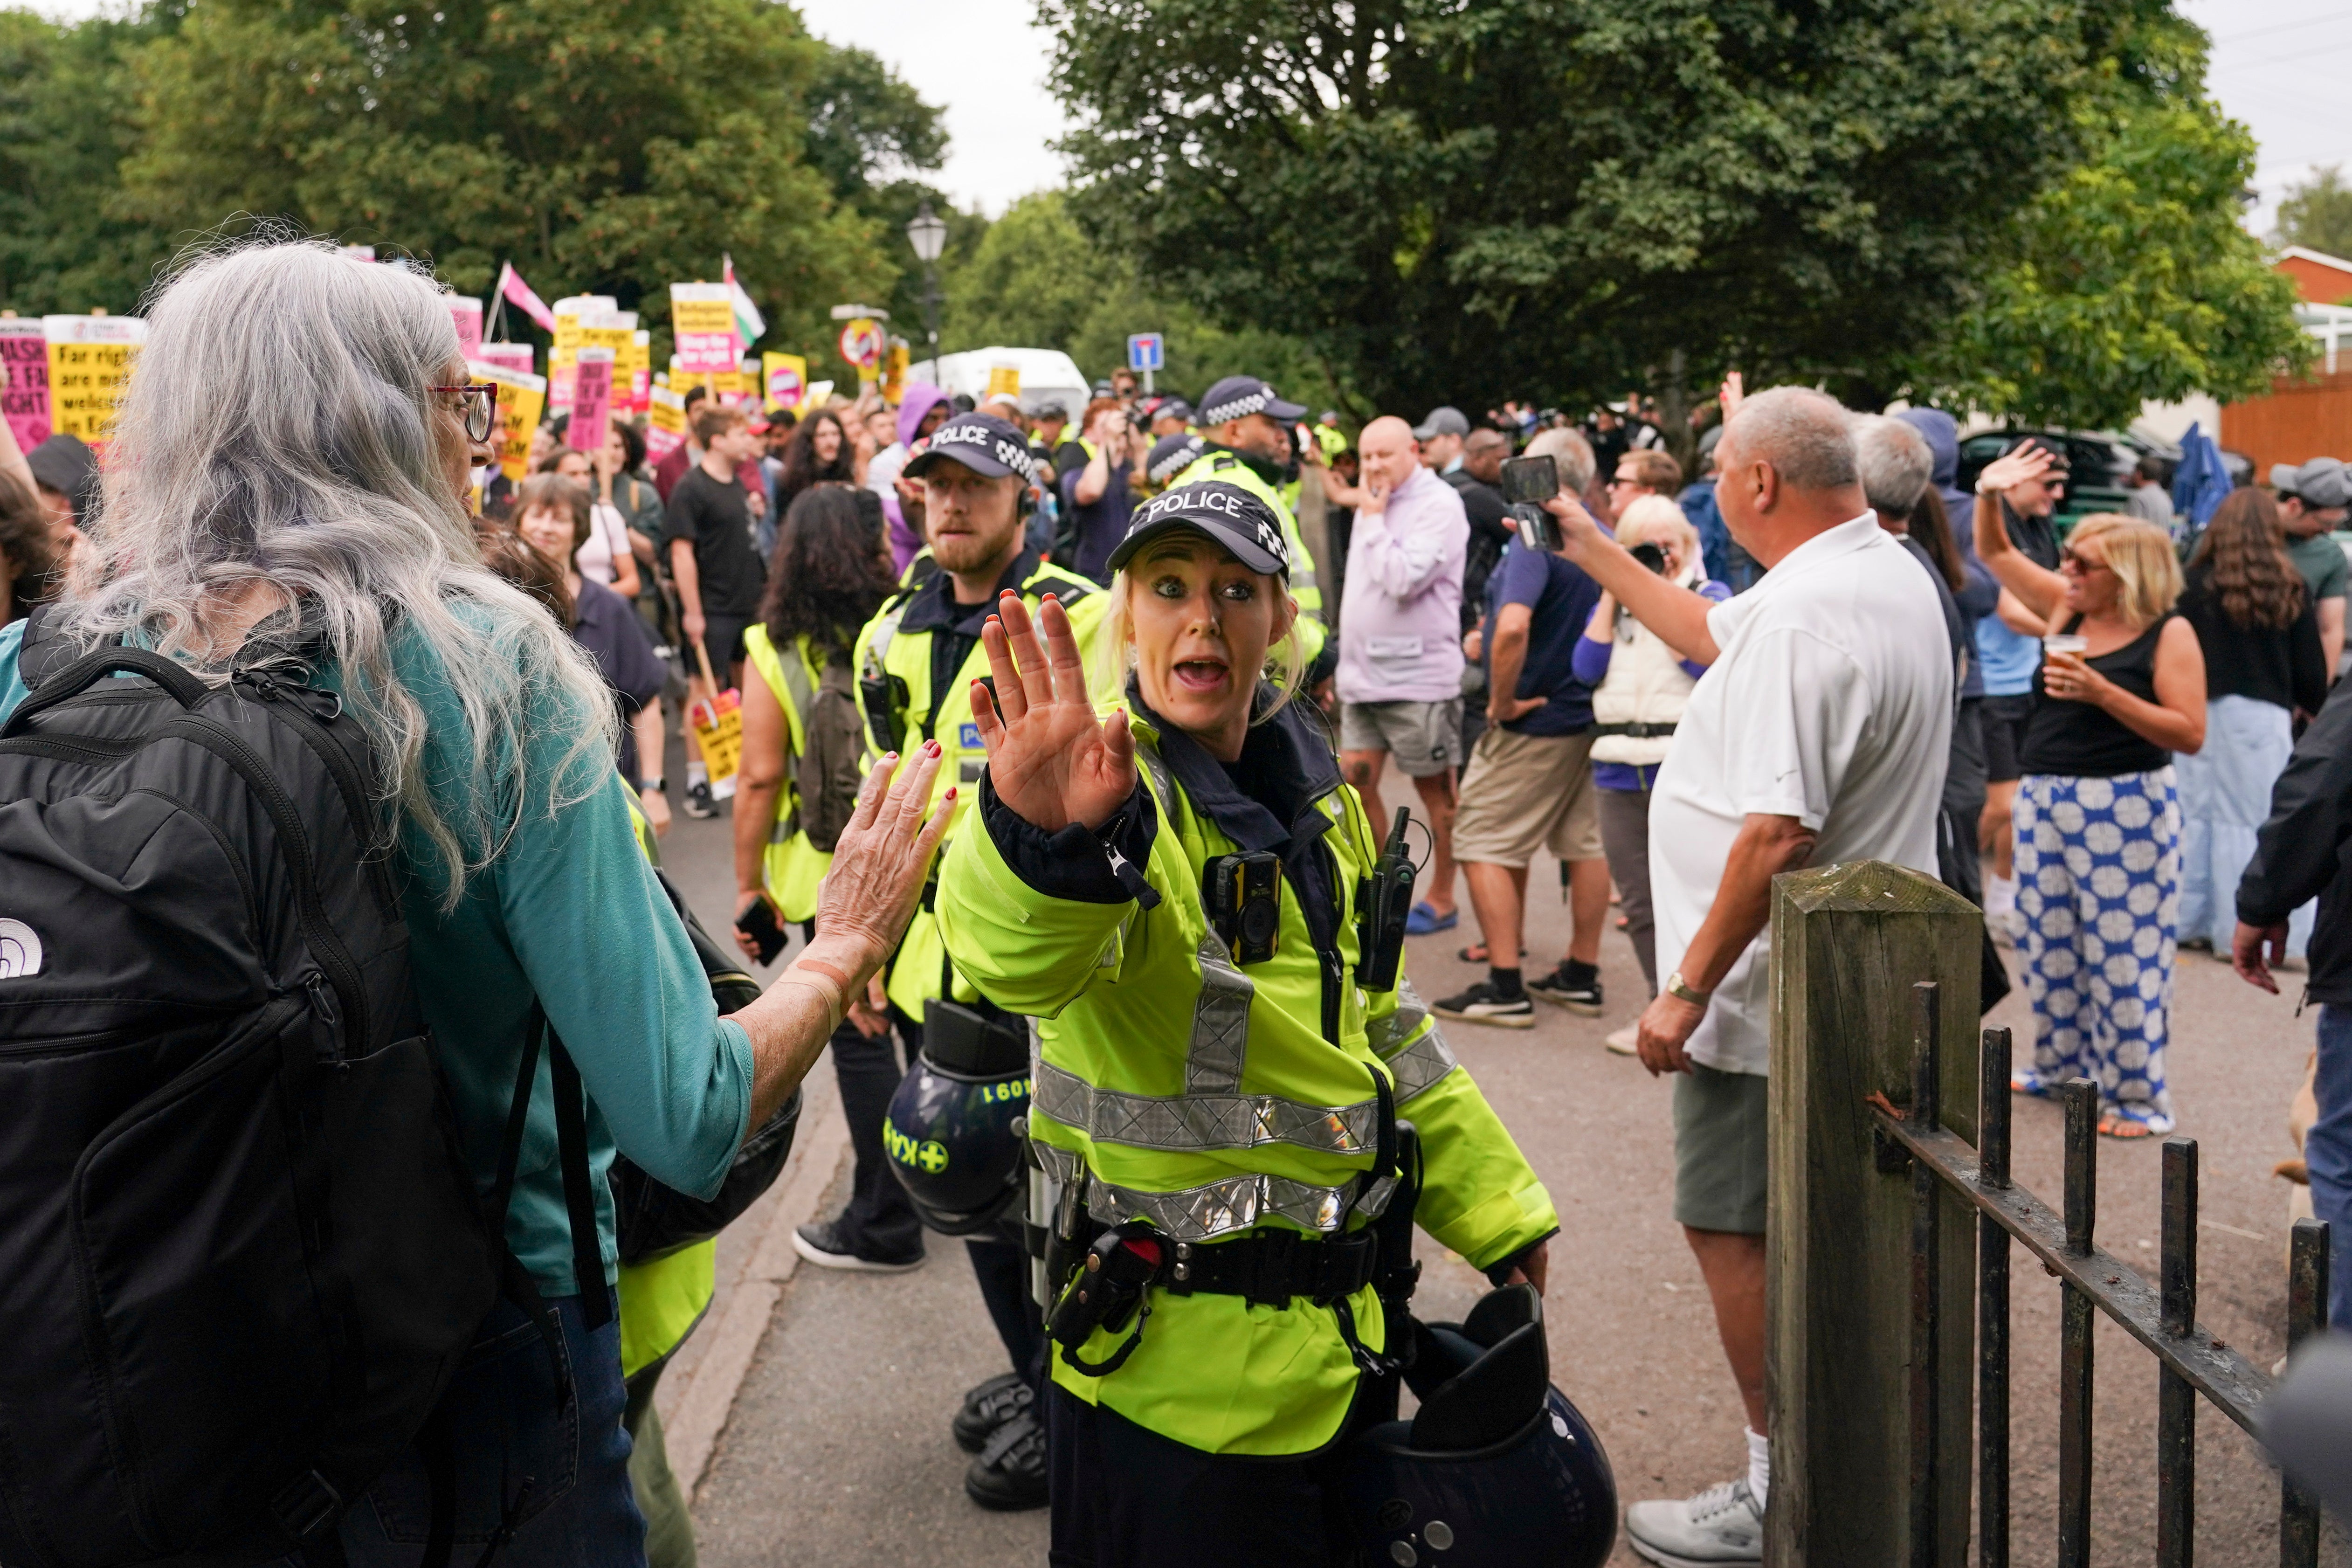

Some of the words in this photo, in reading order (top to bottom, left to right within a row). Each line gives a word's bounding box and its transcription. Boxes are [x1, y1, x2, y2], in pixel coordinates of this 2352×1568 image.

[59, 345, 87, 363] Far
[931, 425, 989, 450] POLICE
[1147, 491, 1242, 523] POLICE
